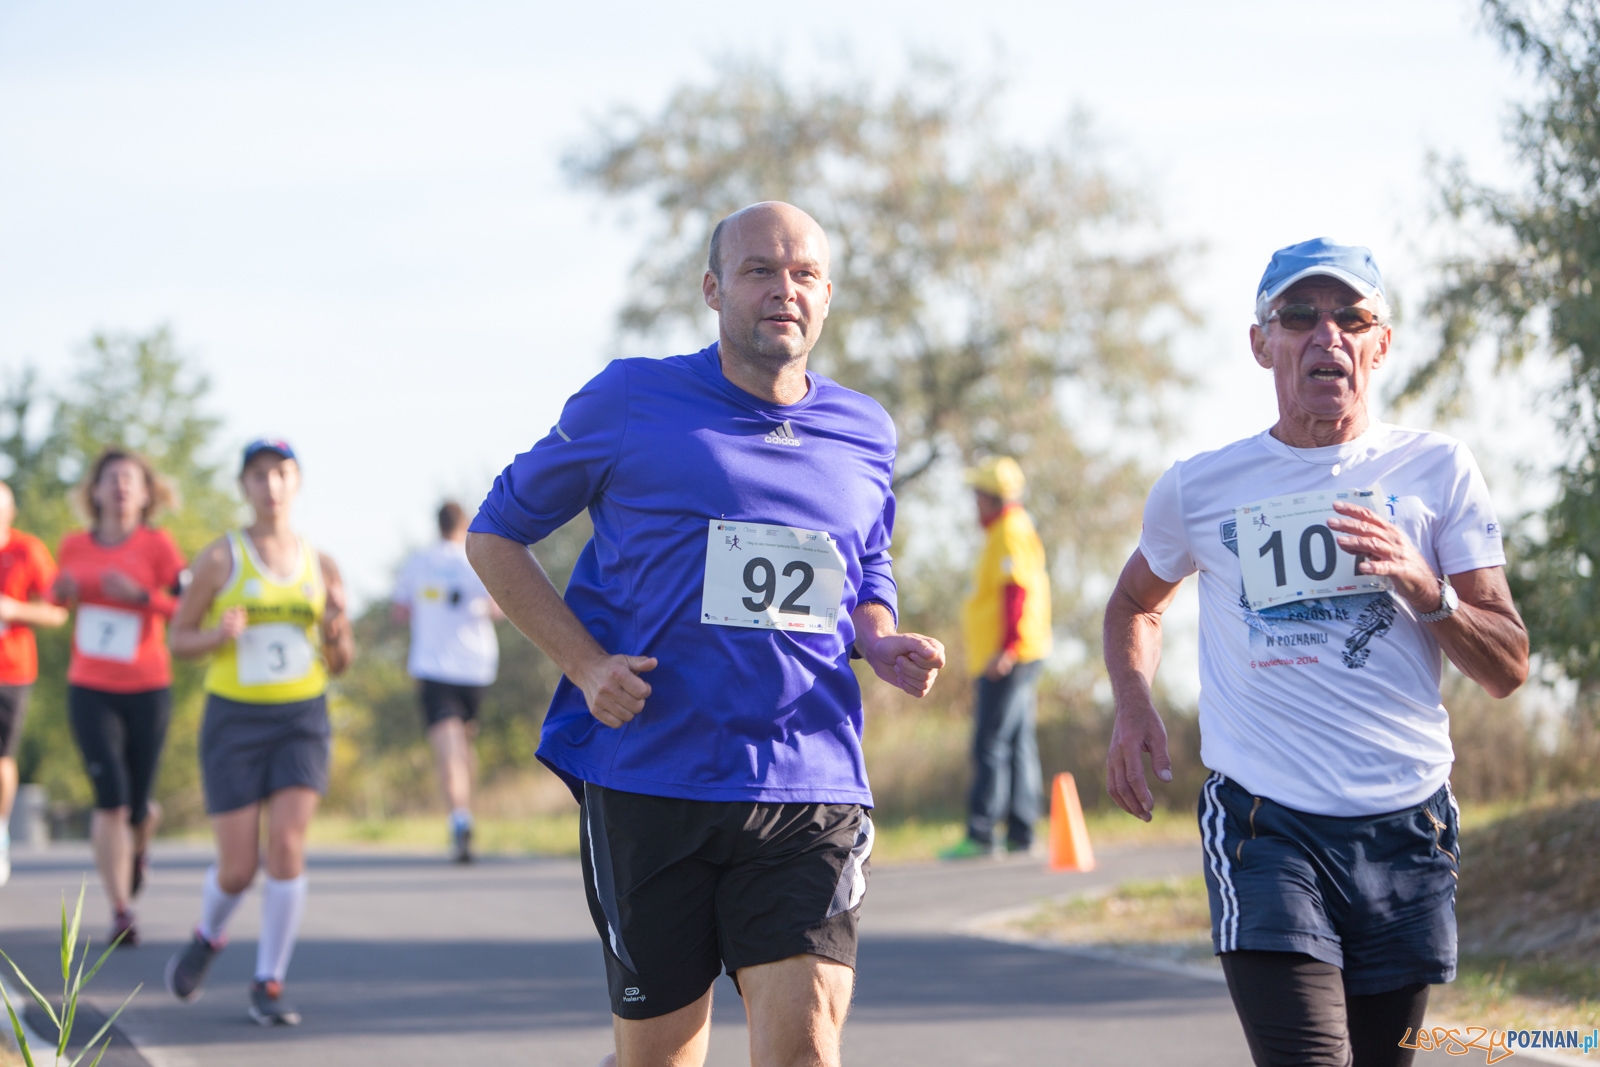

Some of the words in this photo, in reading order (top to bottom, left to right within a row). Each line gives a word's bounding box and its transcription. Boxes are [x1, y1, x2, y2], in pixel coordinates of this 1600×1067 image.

[764, 436, 801, 447] adidas
[742, 556, 815, 616] 92
[1277, 633, 1328, 647] POZNANIU
[268, 641, 286, 673] 3
[1251, 661, 1256, 669] 6
[1259, 658, 1294, 668] kwietnia
[1296, 656, 1319, 665] 2014
